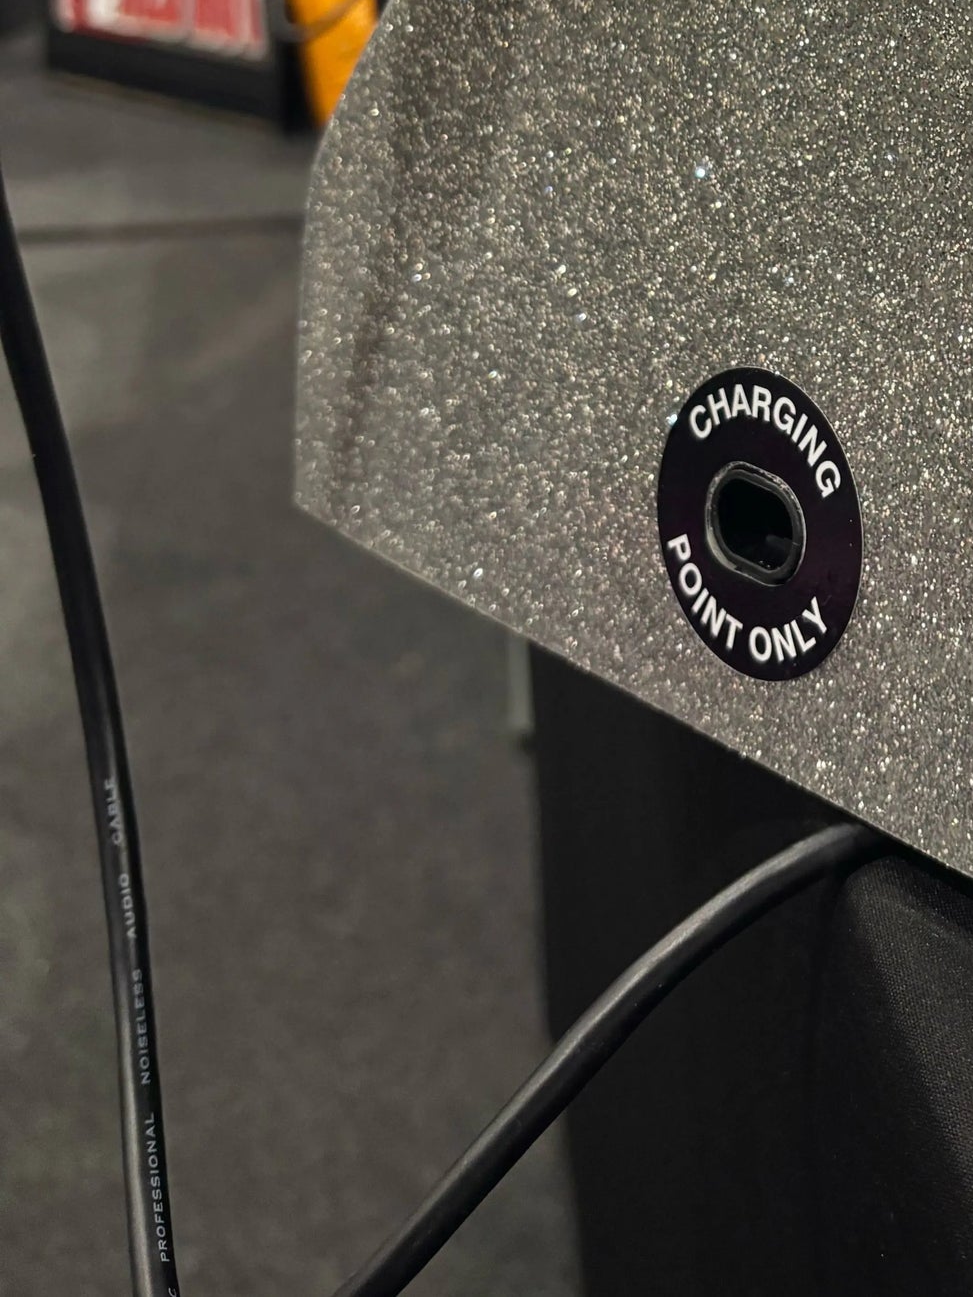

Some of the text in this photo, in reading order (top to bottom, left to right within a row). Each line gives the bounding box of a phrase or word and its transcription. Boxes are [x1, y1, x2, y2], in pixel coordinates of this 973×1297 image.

[689, 384, 842, 499] CHARGING
[667, 533, 829, 663] POINT ONLY
[103, 777, 170, 1262] PROFESSIONAL NOISELESS AUDIO CABLE
